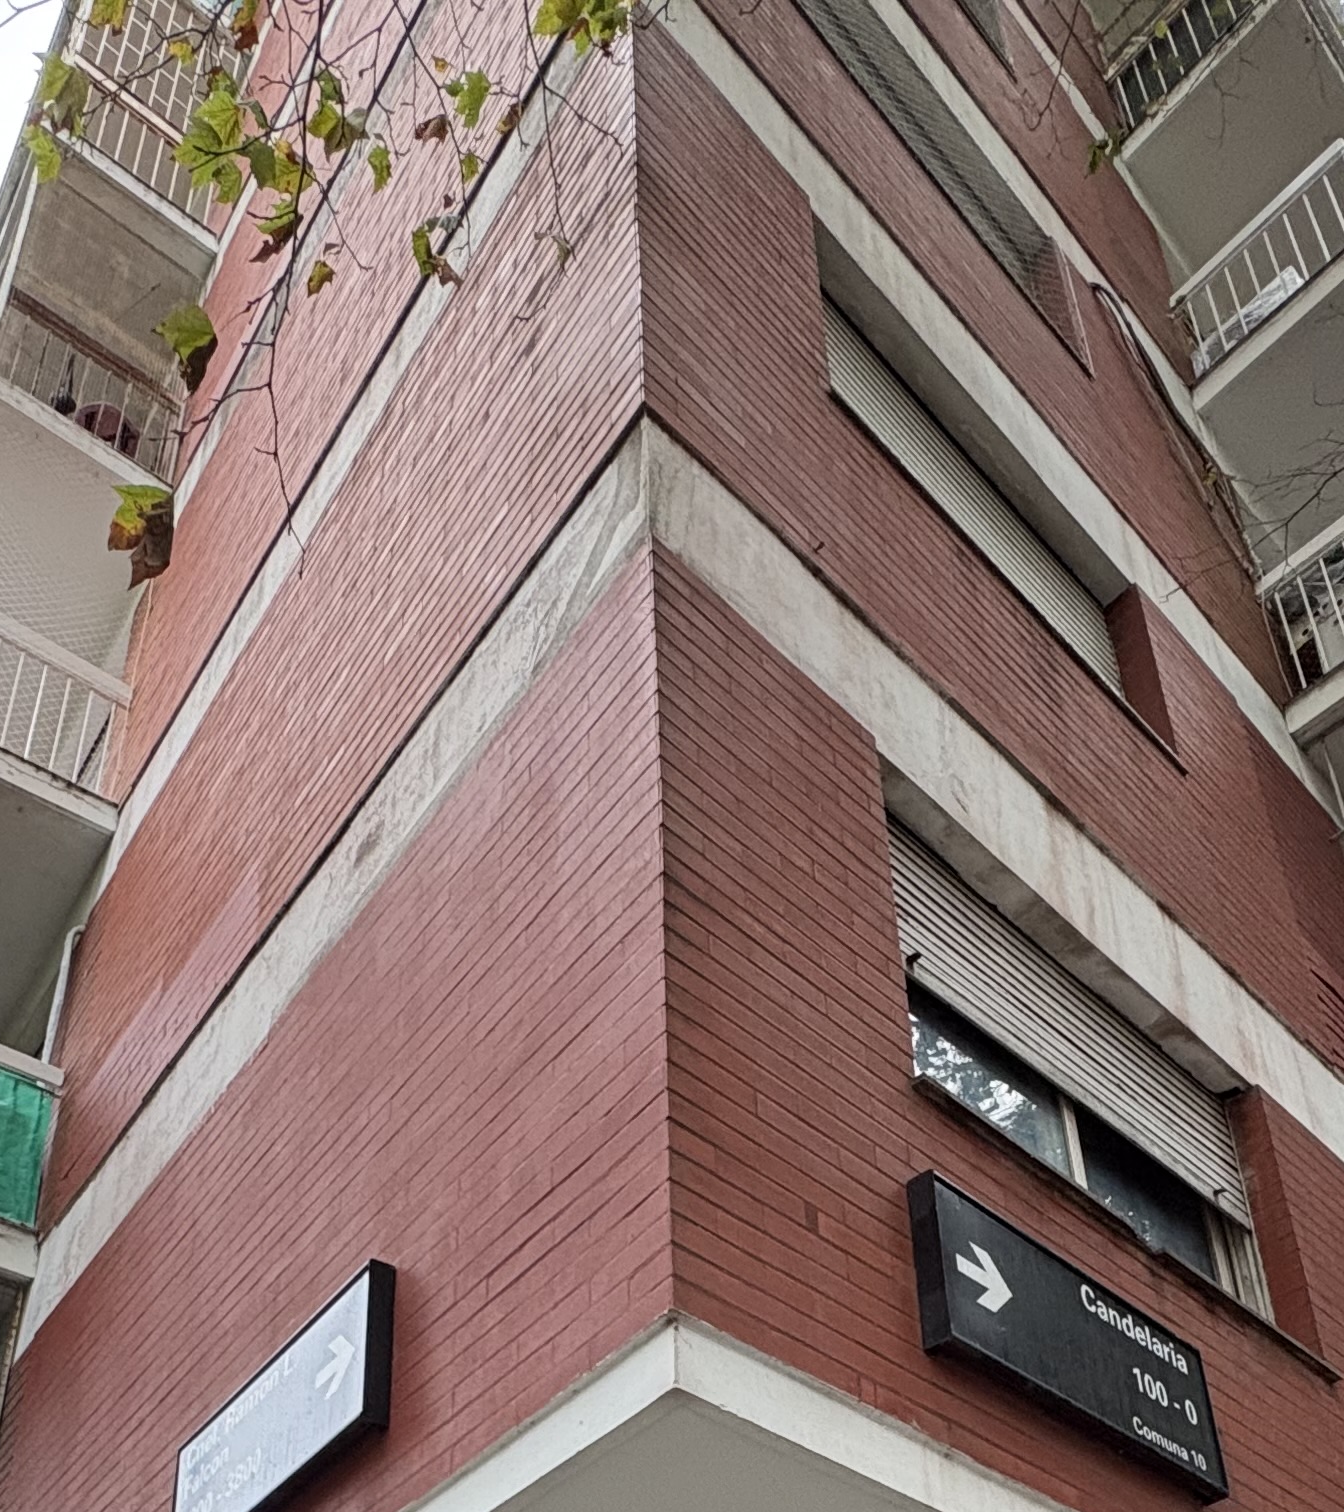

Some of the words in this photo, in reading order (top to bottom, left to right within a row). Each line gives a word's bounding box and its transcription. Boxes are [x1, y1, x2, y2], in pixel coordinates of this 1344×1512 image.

[1080, 1284, 1189, 1375] Candelaria
[1132, 1367, 1169, 1408] 100
[1184, 1399, 1199, 1426] 0
[1132, 1416, 1189, 1462] Comuna
[1190, 1450, 1207, 1471] 10
